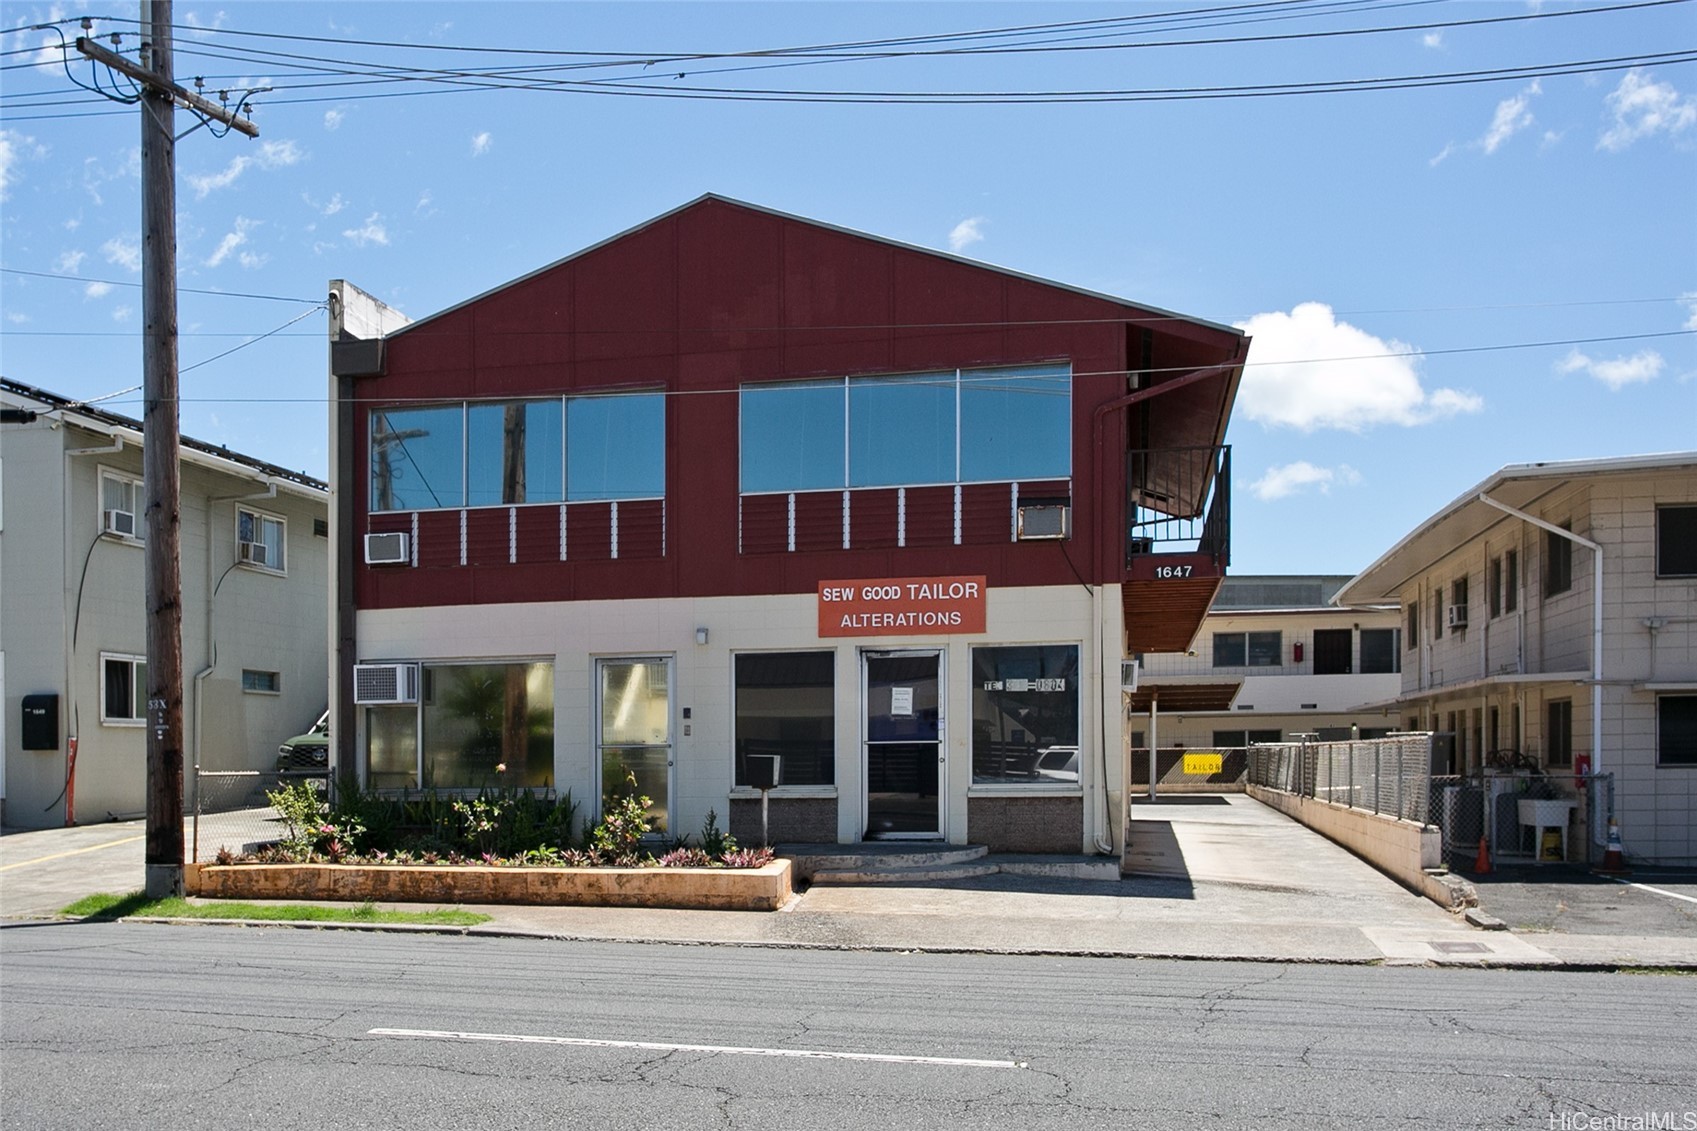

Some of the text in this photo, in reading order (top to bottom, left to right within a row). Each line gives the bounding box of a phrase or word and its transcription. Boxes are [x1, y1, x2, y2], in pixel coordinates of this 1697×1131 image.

[1156, 565, 1192, 578] 1647
[822, 582, 978, 601] SEW GOOD TAILOR
[840, 611, 961, 627] ALTERATIONS
[1186, 763, 1221, 771] TAILOR
